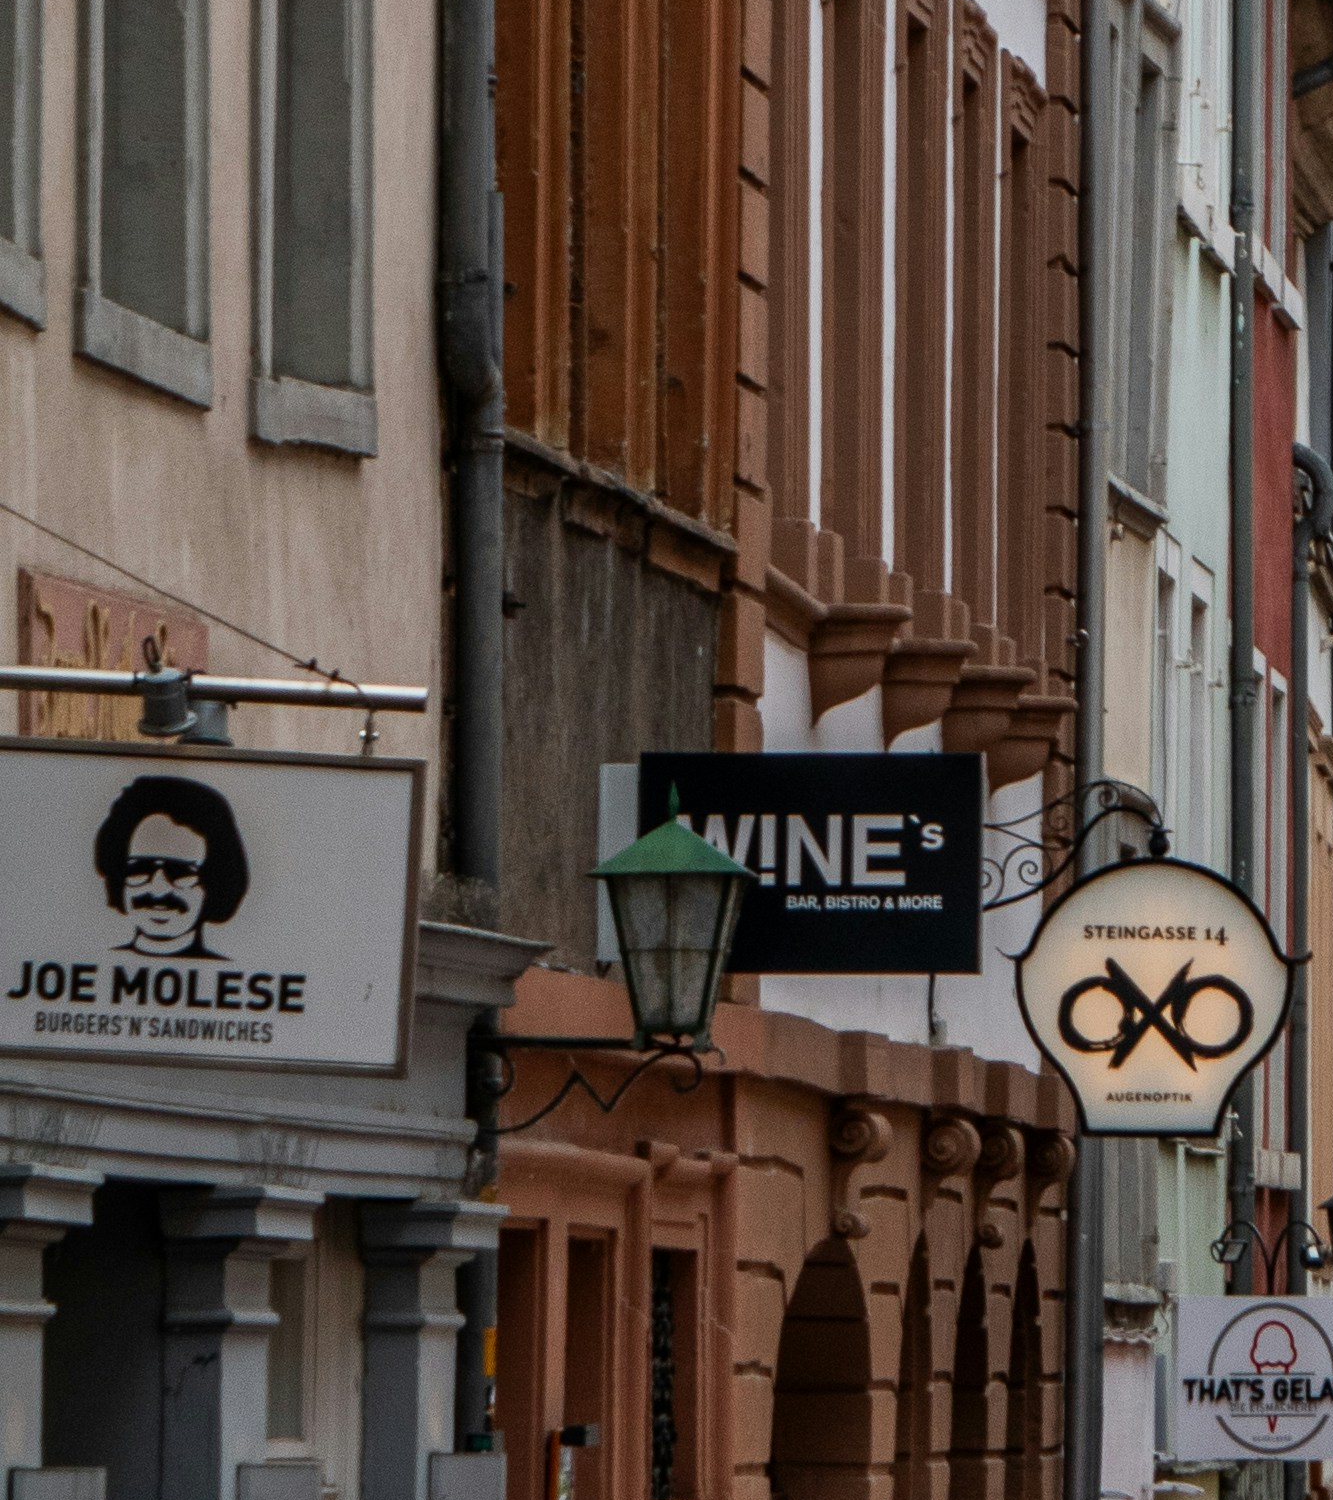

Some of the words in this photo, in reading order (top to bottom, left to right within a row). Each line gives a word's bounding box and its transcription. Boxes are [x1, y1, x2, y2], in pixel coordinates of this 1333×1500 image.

[786, 895, 822, 911] BAR,
[825, 895, 881, 909] BISTRO
[884, 895, 895, 909] &
[898, 895, 943, 909] MORE
[1083, 925, 1197, 941] STEINGASSE
[1203, 926, 1229, 947] 14
[7, 960, 99, 1002] JOE
[110, 965, 307, 1014] MOLESE
[1106, 1091, 1193, 1103] AUGENOPTIK
[1183, 1378, 1265, 1402] THAT'S
